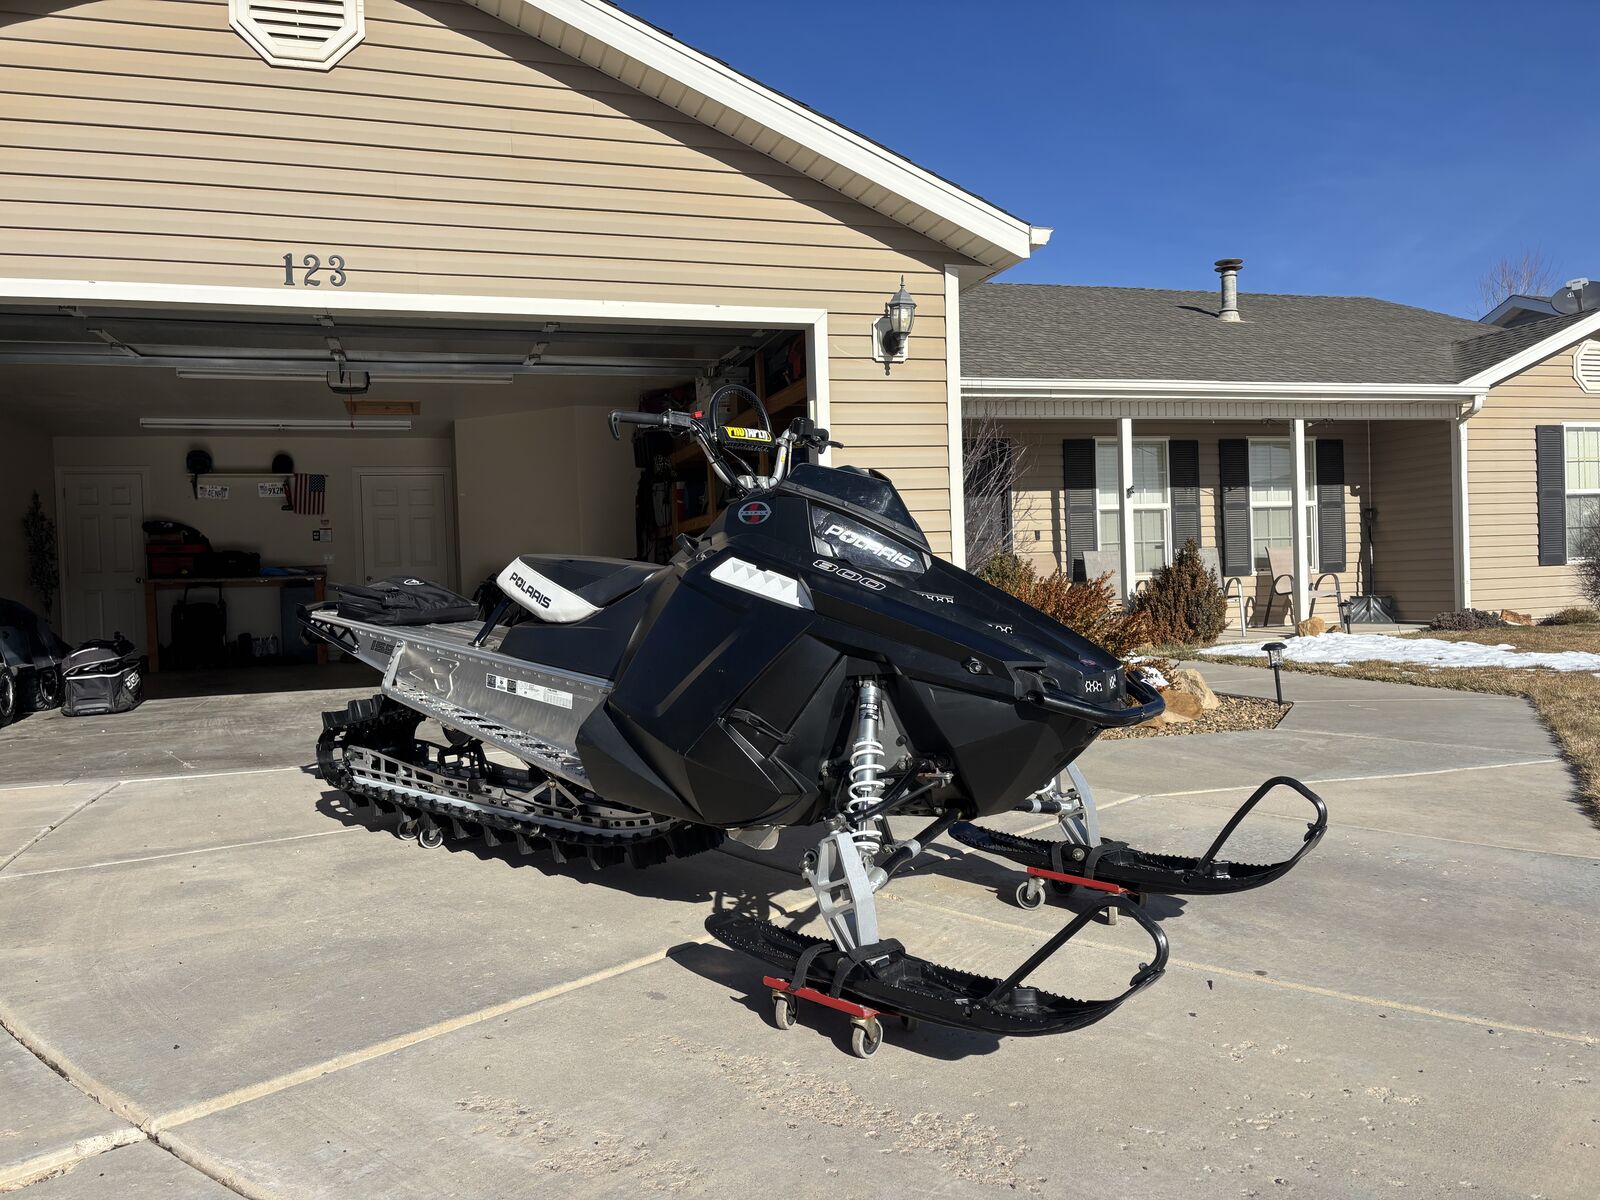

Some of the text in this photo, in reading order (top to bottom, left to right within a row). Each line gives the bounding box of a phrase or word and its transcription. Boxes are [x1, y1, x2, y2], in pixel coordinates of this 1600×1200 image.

[282, 253, 348, 287] 123
[824, 525, 915, 568] POLARIS
[509, 571, 552, 609] POLARIS
[812, 559, 887, 591] 800
